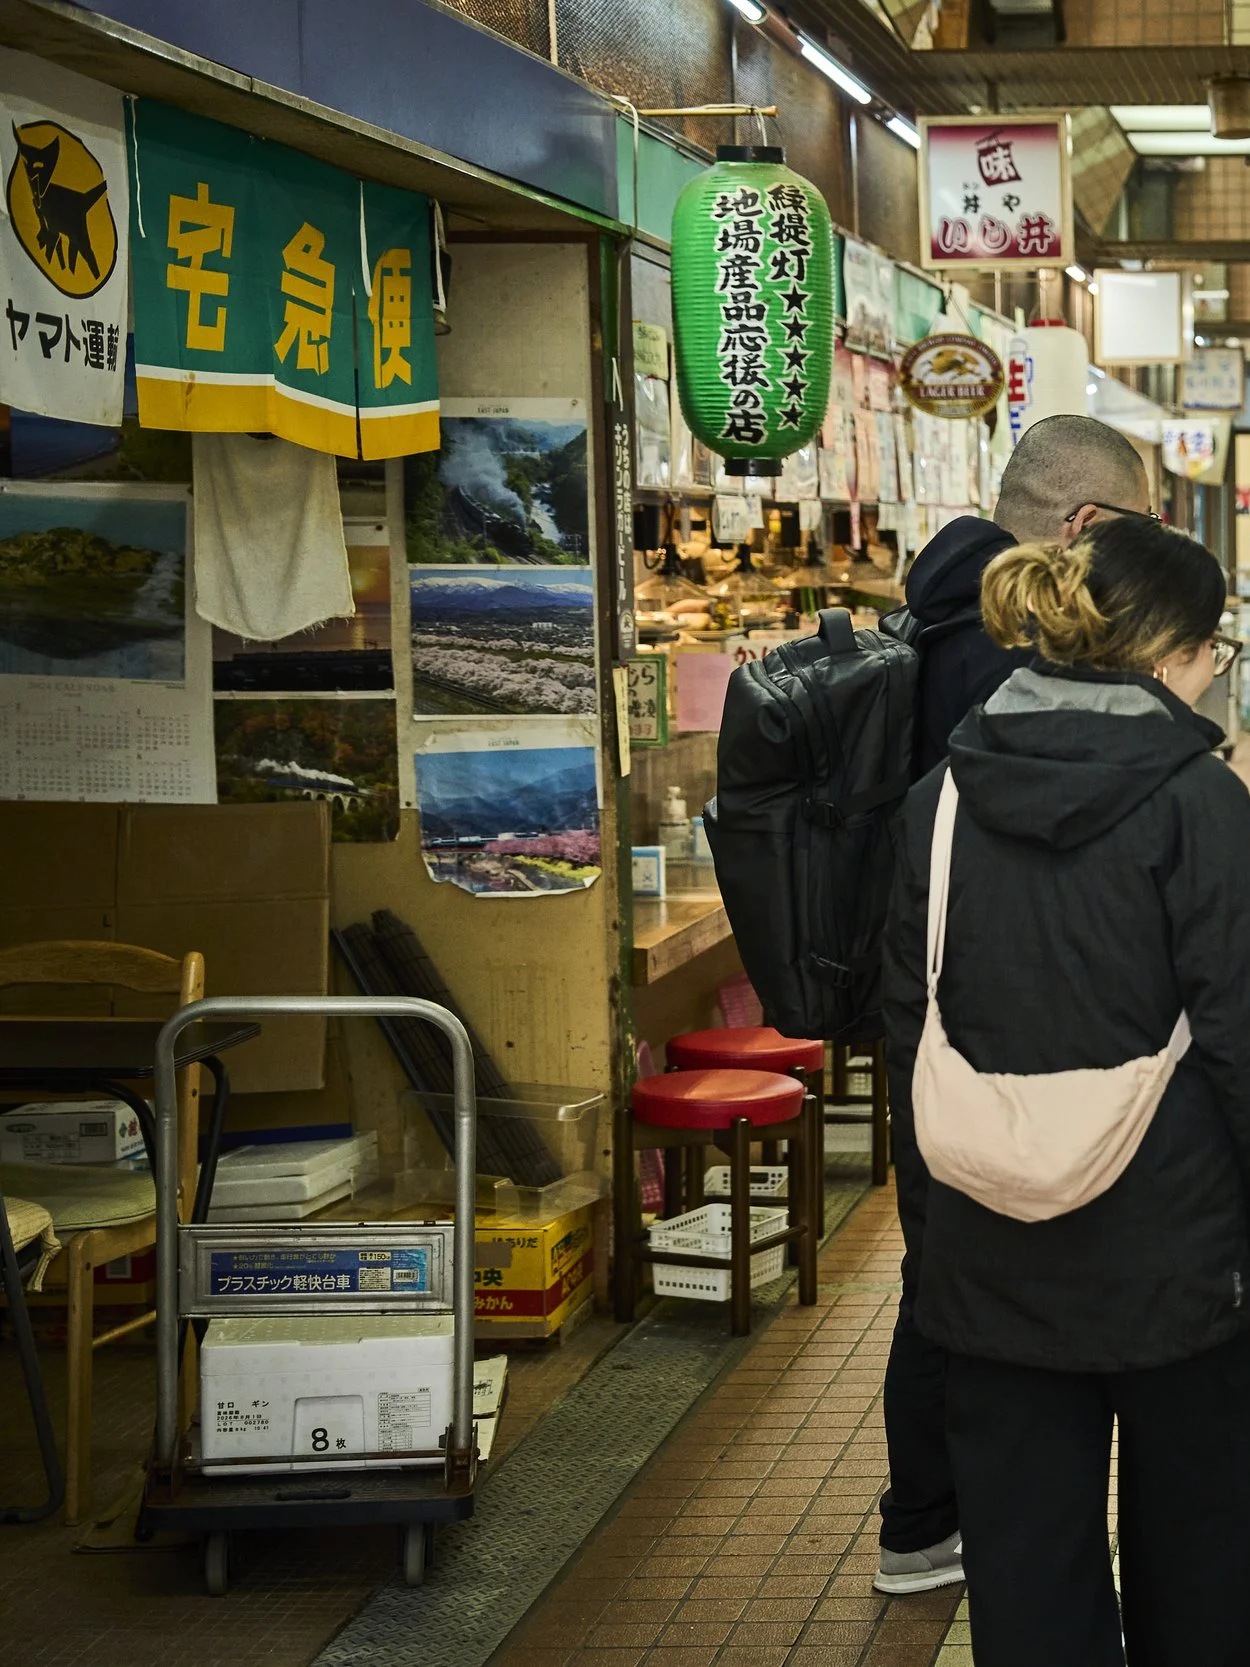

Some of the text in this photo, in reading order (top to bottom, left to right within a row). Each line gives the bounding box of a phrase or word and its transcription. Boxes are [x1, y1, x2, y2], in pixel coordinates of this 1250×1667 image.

[938, 212, 1057, 254] いし井
[166, 182, 412, 389] 宅急便
[715, 189, 769, 444] 地場産品応援の店
[217, 1274, 351, 1292] プラスチック軽快台車
[217, 1400, 269, 1410] 甘口 ギン
